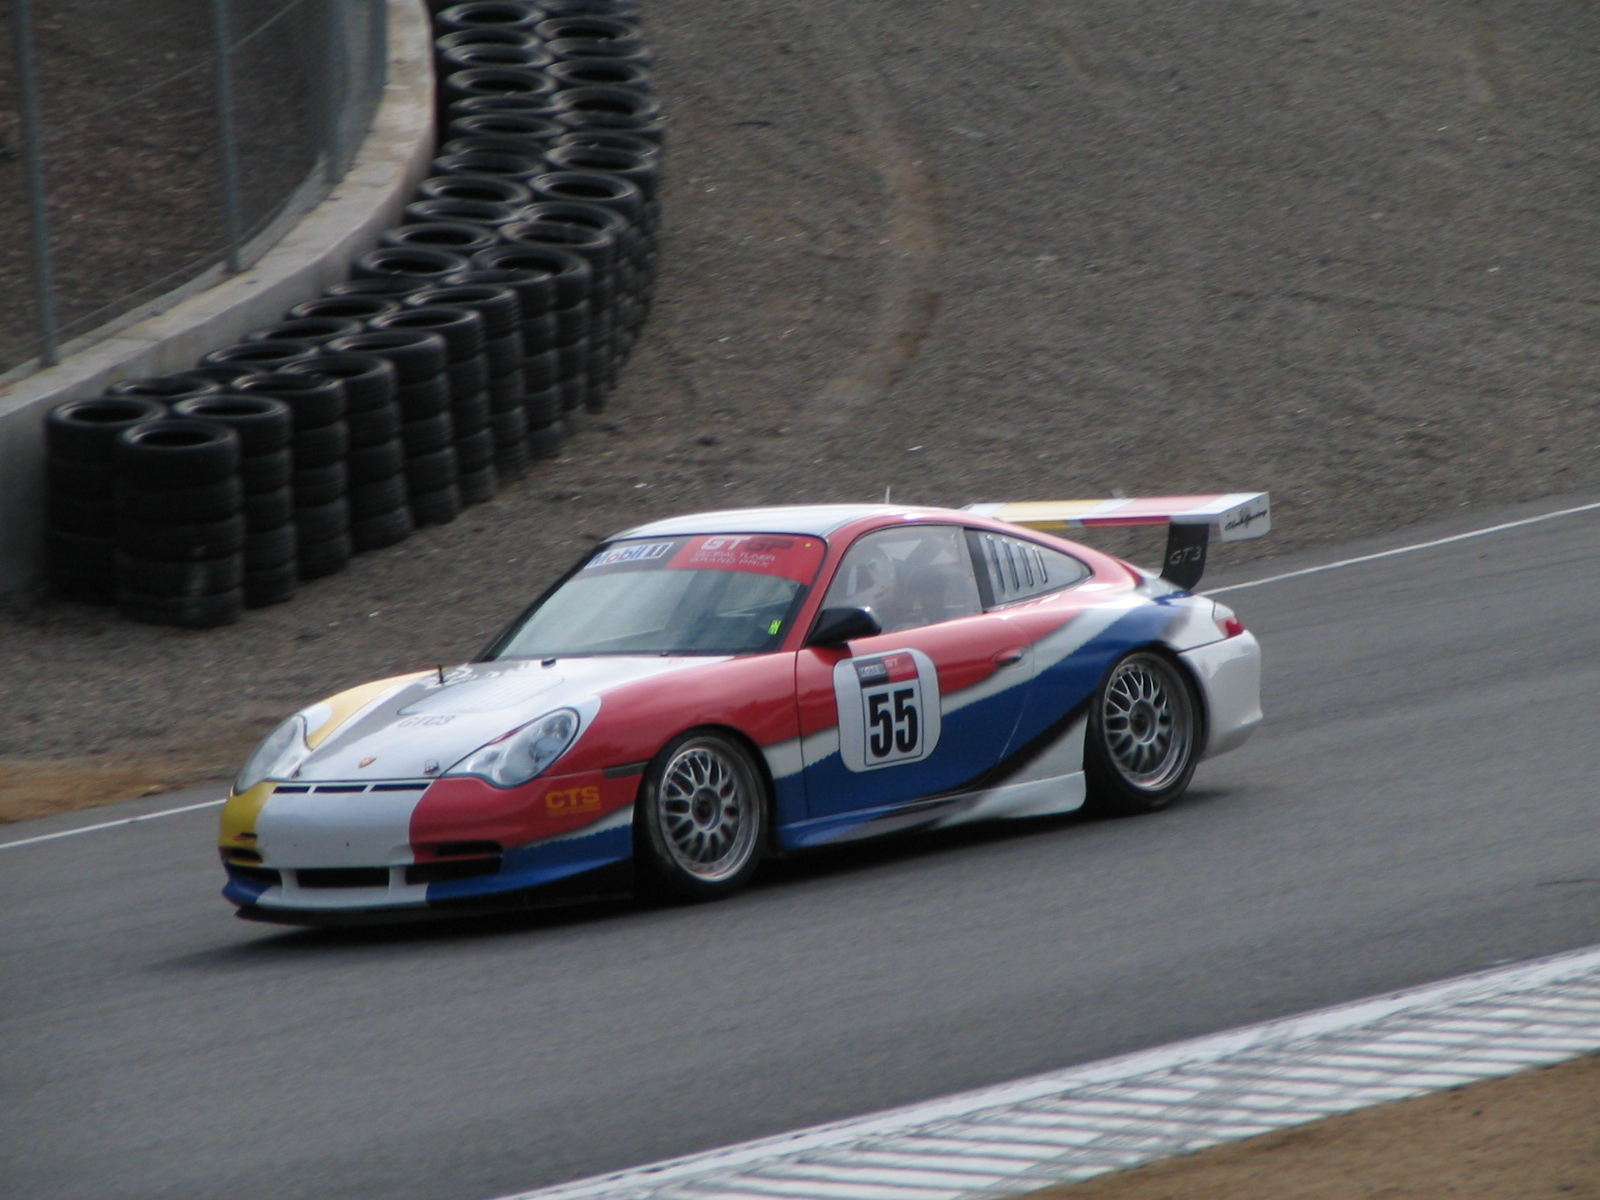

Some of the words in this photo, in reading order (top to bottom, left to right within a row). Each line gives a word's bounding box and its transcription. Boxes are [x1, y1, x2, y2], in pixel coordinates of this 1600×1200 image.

[586, 546, 648, 567] Mobil
[738, 558, 770, 567] PRIX
[868, 688, 918, 758] 55
[545, 786, 600, 808] CTS
